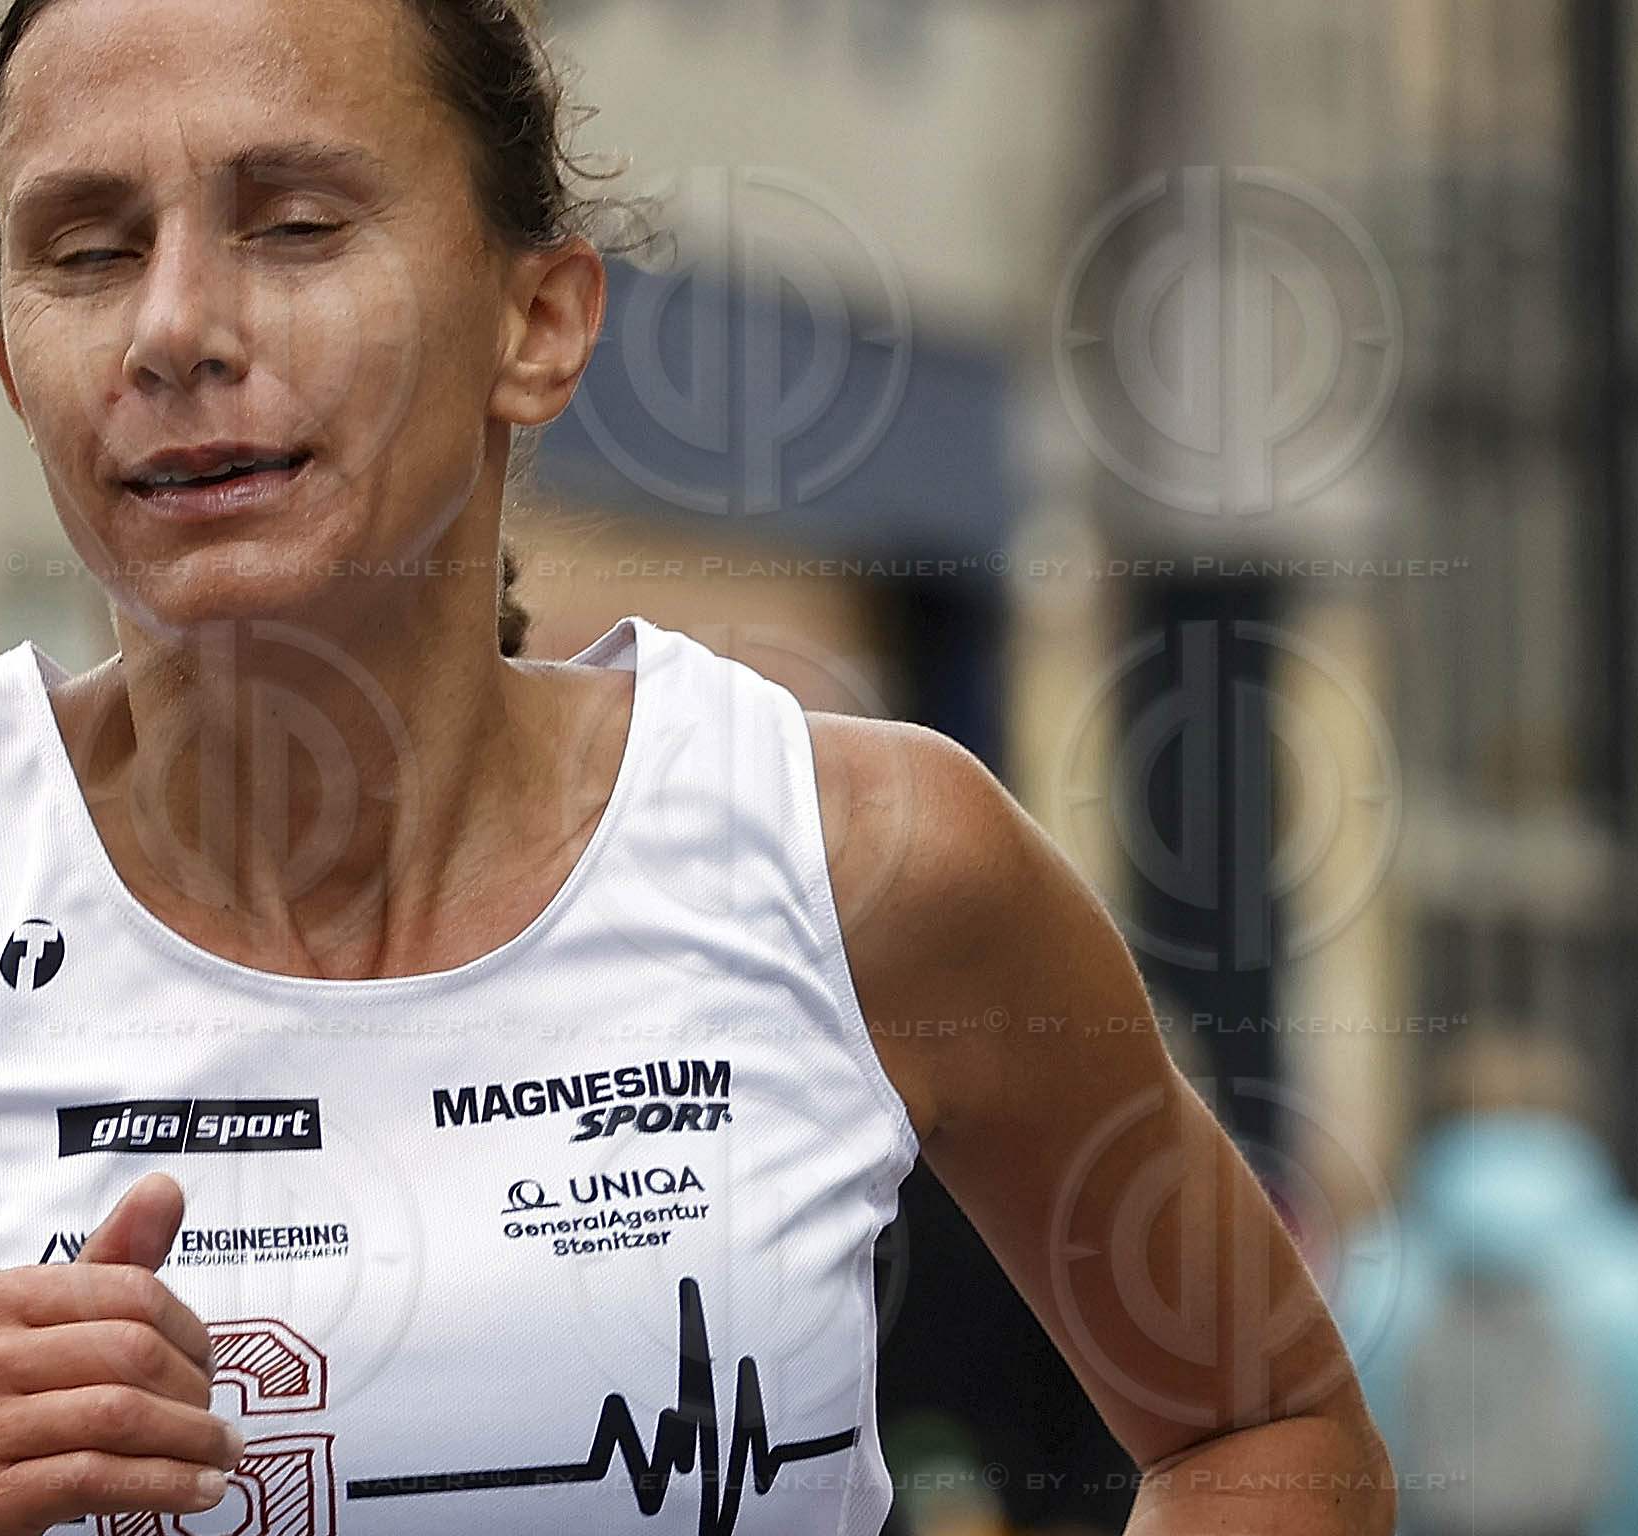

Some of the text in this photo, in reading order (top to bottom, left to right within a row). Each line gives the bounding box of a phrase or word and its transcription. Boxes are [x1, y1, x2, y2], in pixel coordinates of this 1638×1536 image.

[432, 1060, 731, 1128] MAGNESIUM
[90, 1108, 311, 1148] giga sport
[569, 1165, 705, 1203] UNIQA
[181, 1223, 349, 1252] ENGINEERING
[503, 1202, 710, 1238] GeneralAgentur
[177, 1251, 248, 1267] RESOURCE
[254, 1245, 349, 1264] MANAGEMENT
[552, 1230, 672, 1256] Stenitzer
